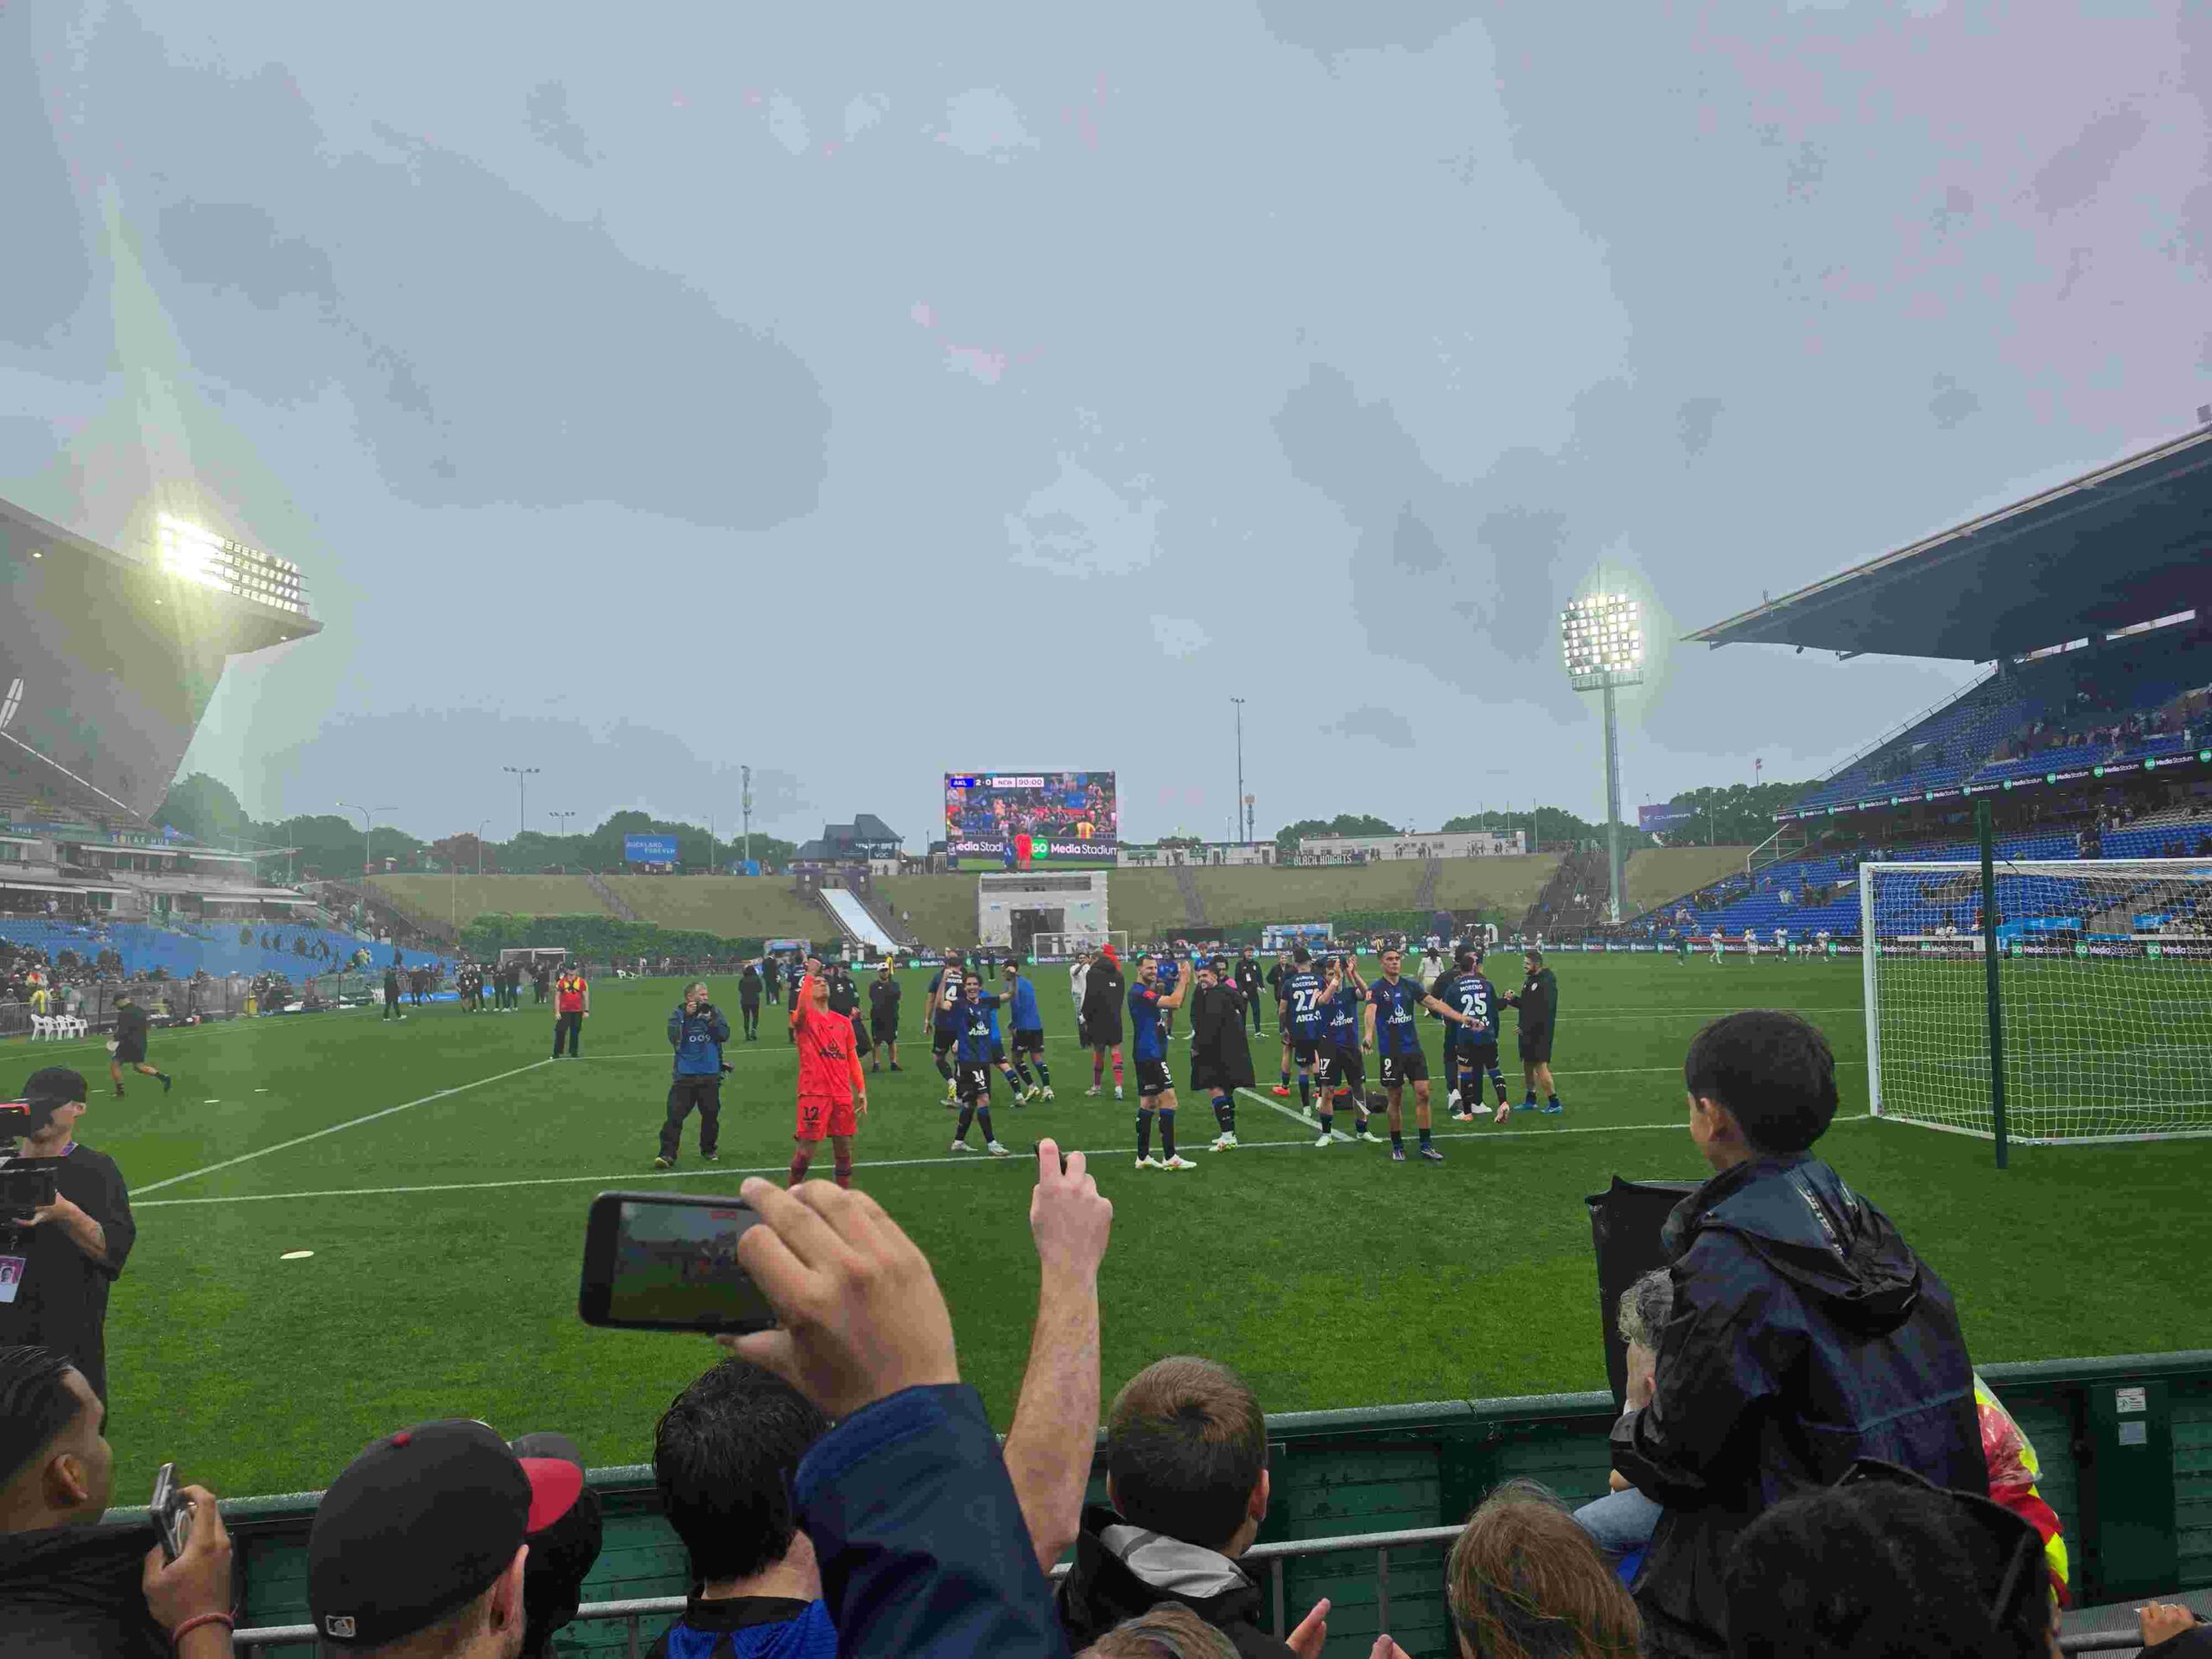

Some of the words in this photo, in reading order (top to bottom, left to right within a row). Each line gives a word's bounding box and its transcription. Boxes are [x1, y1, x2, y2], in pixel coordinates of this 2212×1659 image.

[2104, 766, 2120, 774] Media
[1032, 843, 1047, 852] GO
[1051, 843, 1081, 854] Media
[1294, 854, 1318, 866] BLACK
[1319, 853, 1352, 865] KNIGHTS
[2163, 945, 2186, 954] Media
[945, 985, 958, 1001] 4
[1293, 988, 1319, 1012] 27
[1460, 993, 1487, 1017] 25
[1319, 1058, 1331, 1071] 17
[1384, 1058, 1392, 1071] 9
